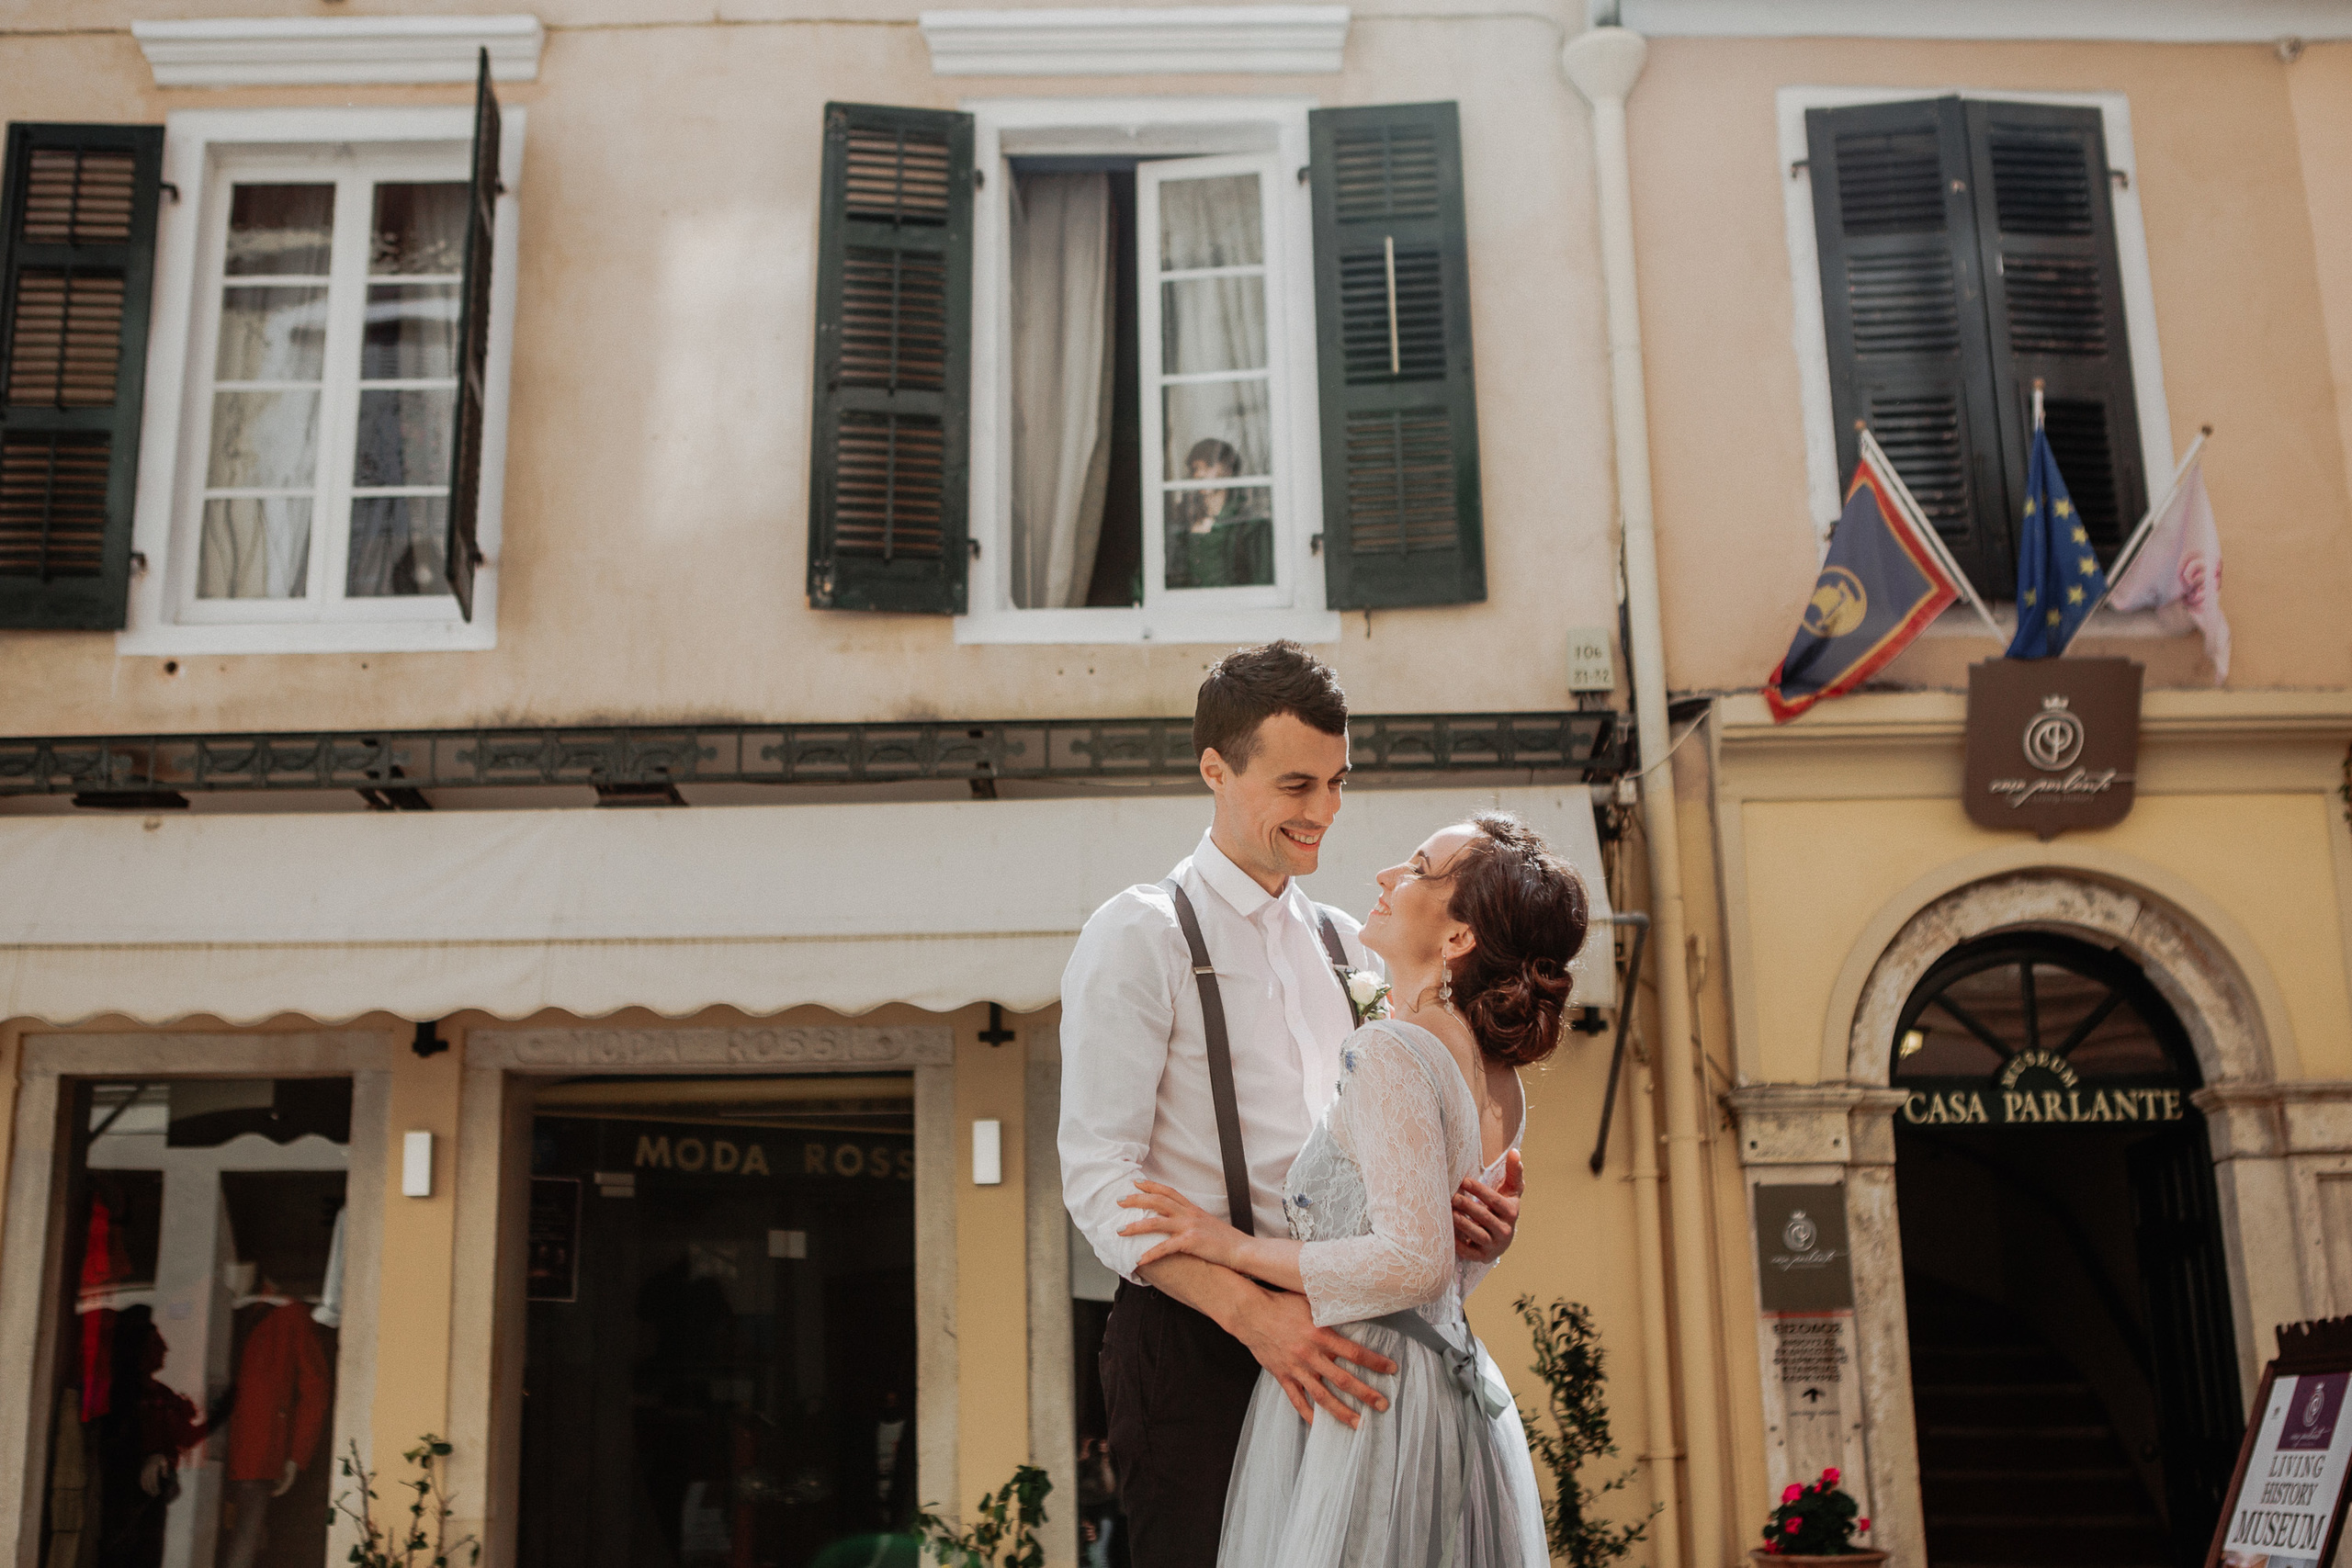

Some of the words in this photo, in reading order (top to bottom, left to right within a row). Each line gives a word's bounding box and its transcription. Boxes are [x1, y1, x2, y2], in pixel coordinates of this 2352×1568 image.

[2000, 1048, 2079, 1089] MUSEUM
[1903, 1091, 1989, 1124] CASA
[2002, 1088, 2184, 1123] PARLANTE
[634, 1135, 770, 1176] MODA
[2267, 1454, 2327, 1479] LIVING
[2259, 1482, 2320, 1506] HISTORY
[2232, 1509, 2327, 1551] MUSEUM
